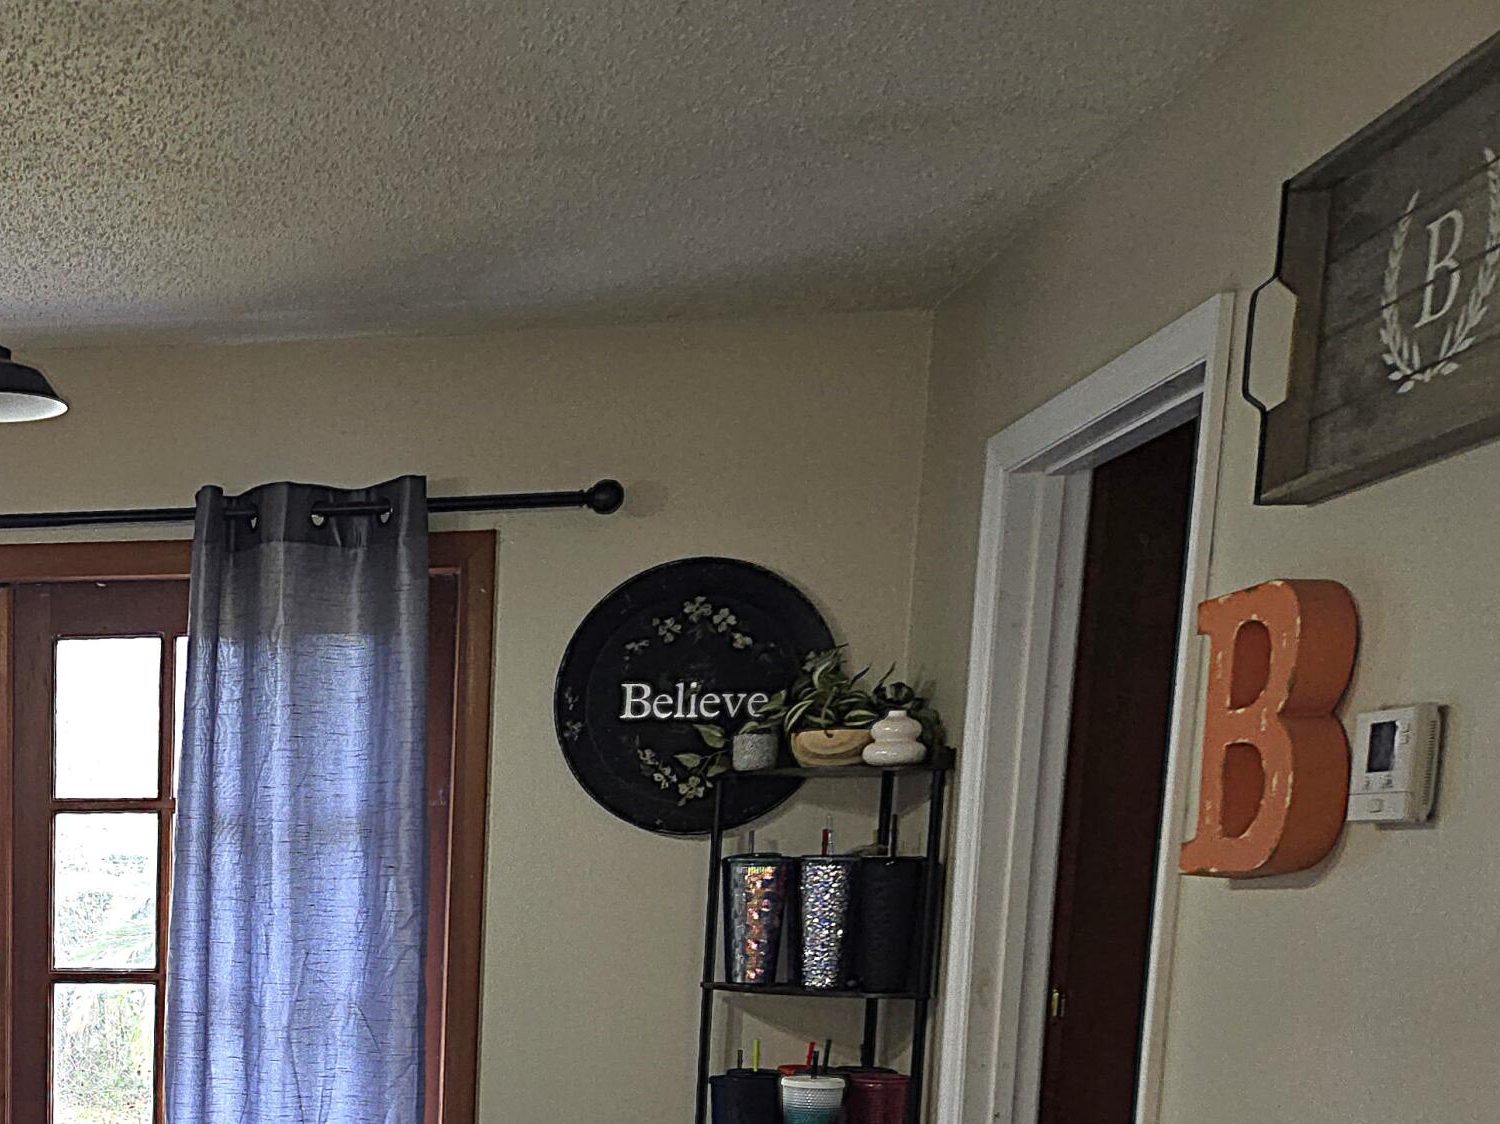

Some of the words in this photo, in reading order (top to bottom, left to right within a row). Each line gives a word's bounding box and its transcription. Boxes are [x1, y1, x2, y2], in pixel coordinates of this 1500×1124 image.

[1413, 208, 1465, 329] B
[619, 681, 769, 720] Believe
[1179, 579, 1357, 879] B
